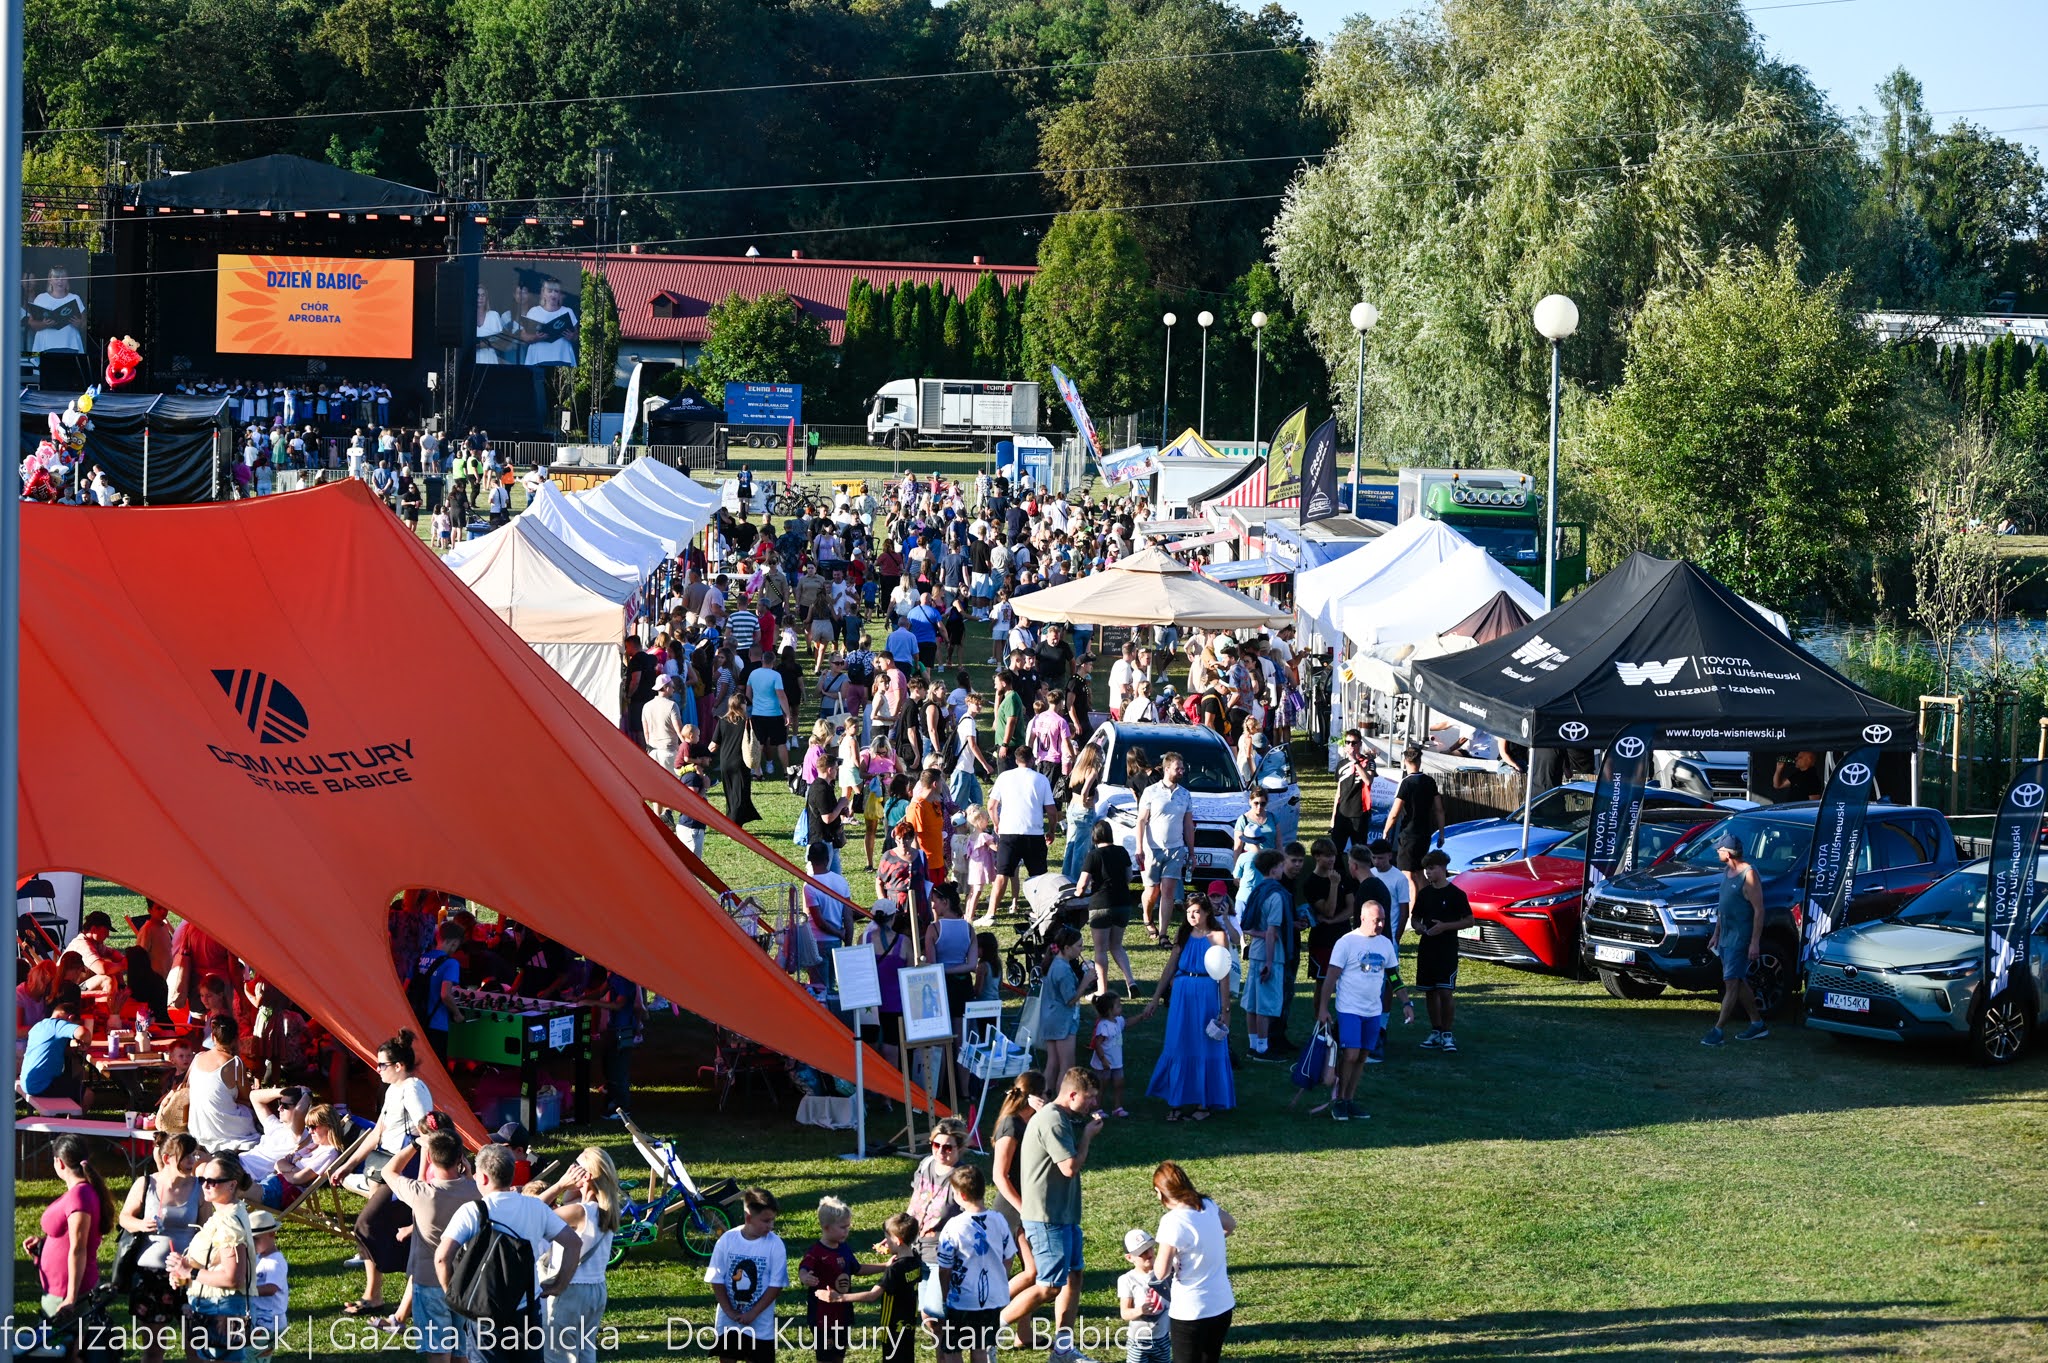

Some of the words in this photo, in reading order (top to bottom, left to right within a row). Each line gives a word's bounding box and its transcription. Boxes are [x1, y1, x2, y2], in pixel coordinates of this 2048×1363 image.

[267, 270, 312, 289] DZIEŃ
[316, 272, 362, 290] BABIC
[288, 314, 341, 323] APROBATA
[301, 301, 329, 311] CHÓR
[1700, 656, 1751, 667] TOYOTA
[1703, 667, 1732, 676] W&J
[1734, 667, 1801, 681] Wiśniewski
[1654, 685, 1719, 697] Warszawa
[1729, 684, 1776, 695] Izabelin
[1666, 728, 1786, 740] www.toyota-wisniewski.pl
[207, 744, 278, 775] DOM
[275, 738, 415, 776] KULTURY
[247, 773, 319, 795] STARE
[323, 768, 413, 793] BABICE
[1608, 773, 1622, 830] Wiśniewski
[1594, 812, 1606, 855] TOYOTA
[1607, 831, 1617, 855] W&J
[1830, 802, 1846, 861] Wiśniewski
[1815, 844, 1829, 889] TOYOTA
[2008, 825, 2021, 889] Wiśniewski
[1996, 871, 2006, 920] TOYOTA
[2008, 892, 2018, 920] W&J
[1829, 994, 1840, 1006] WZ
[1843, 995, 1867, 1009] 154KK
